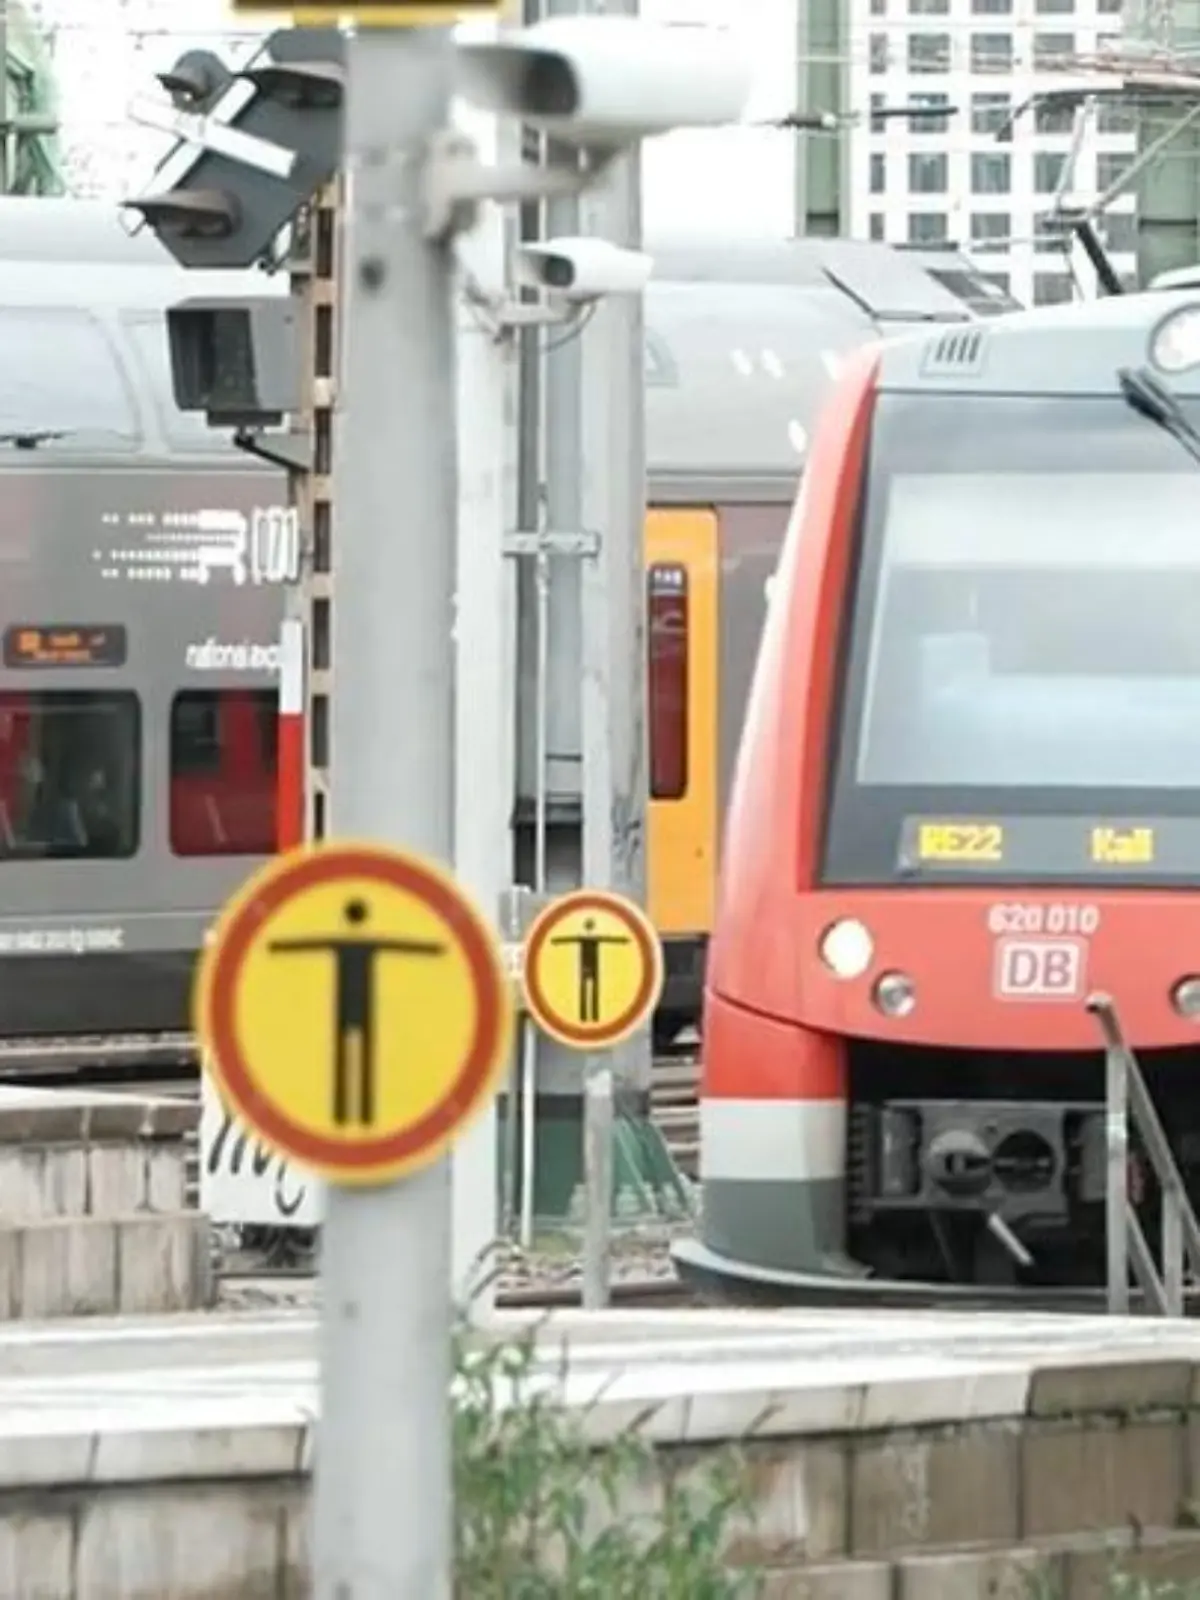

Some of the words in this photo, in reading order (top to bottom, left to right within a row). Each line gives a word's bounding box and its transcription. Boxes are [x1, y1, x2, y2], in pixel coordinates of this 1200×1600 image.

[989, 902, 1042, 933] 620
[1046, 903, 1100, 934] 010
[1008, 948, 1072, 987] DB
